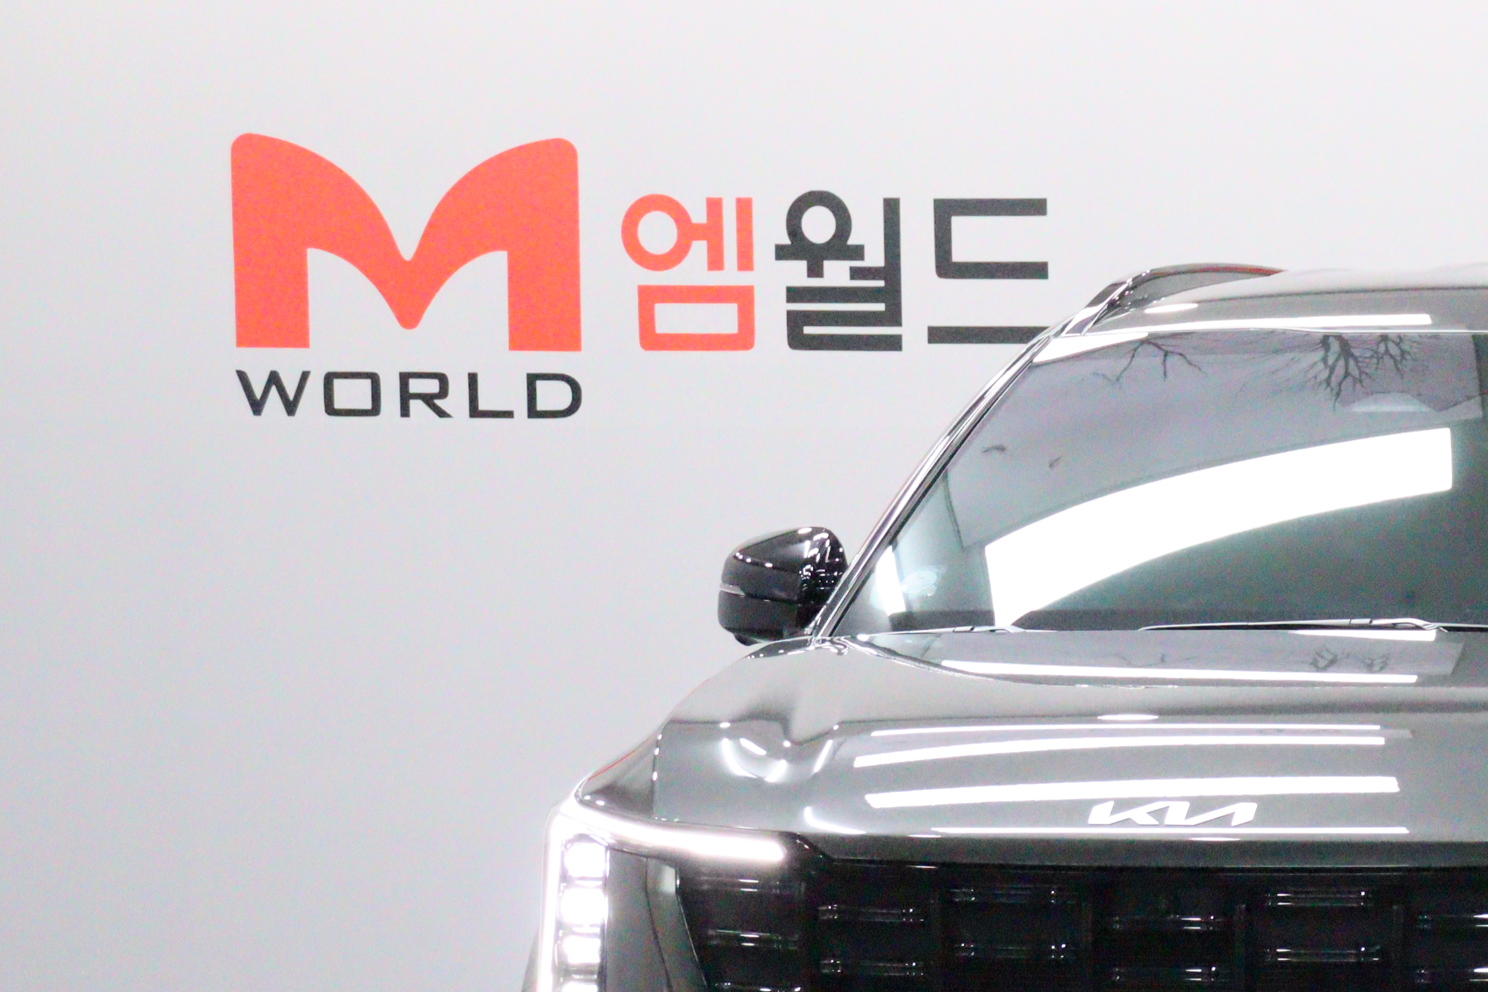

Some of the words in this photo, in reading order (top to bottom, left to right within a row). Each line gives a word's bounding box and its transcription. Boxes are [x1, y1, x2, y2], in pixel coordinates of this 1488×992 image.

[231, 132, 583, 352] M
[621, 190, 1049, 352] 엠월드
[235, 369, 583, 420] WORLD
[1088, 801, 1258, 827] KIA
